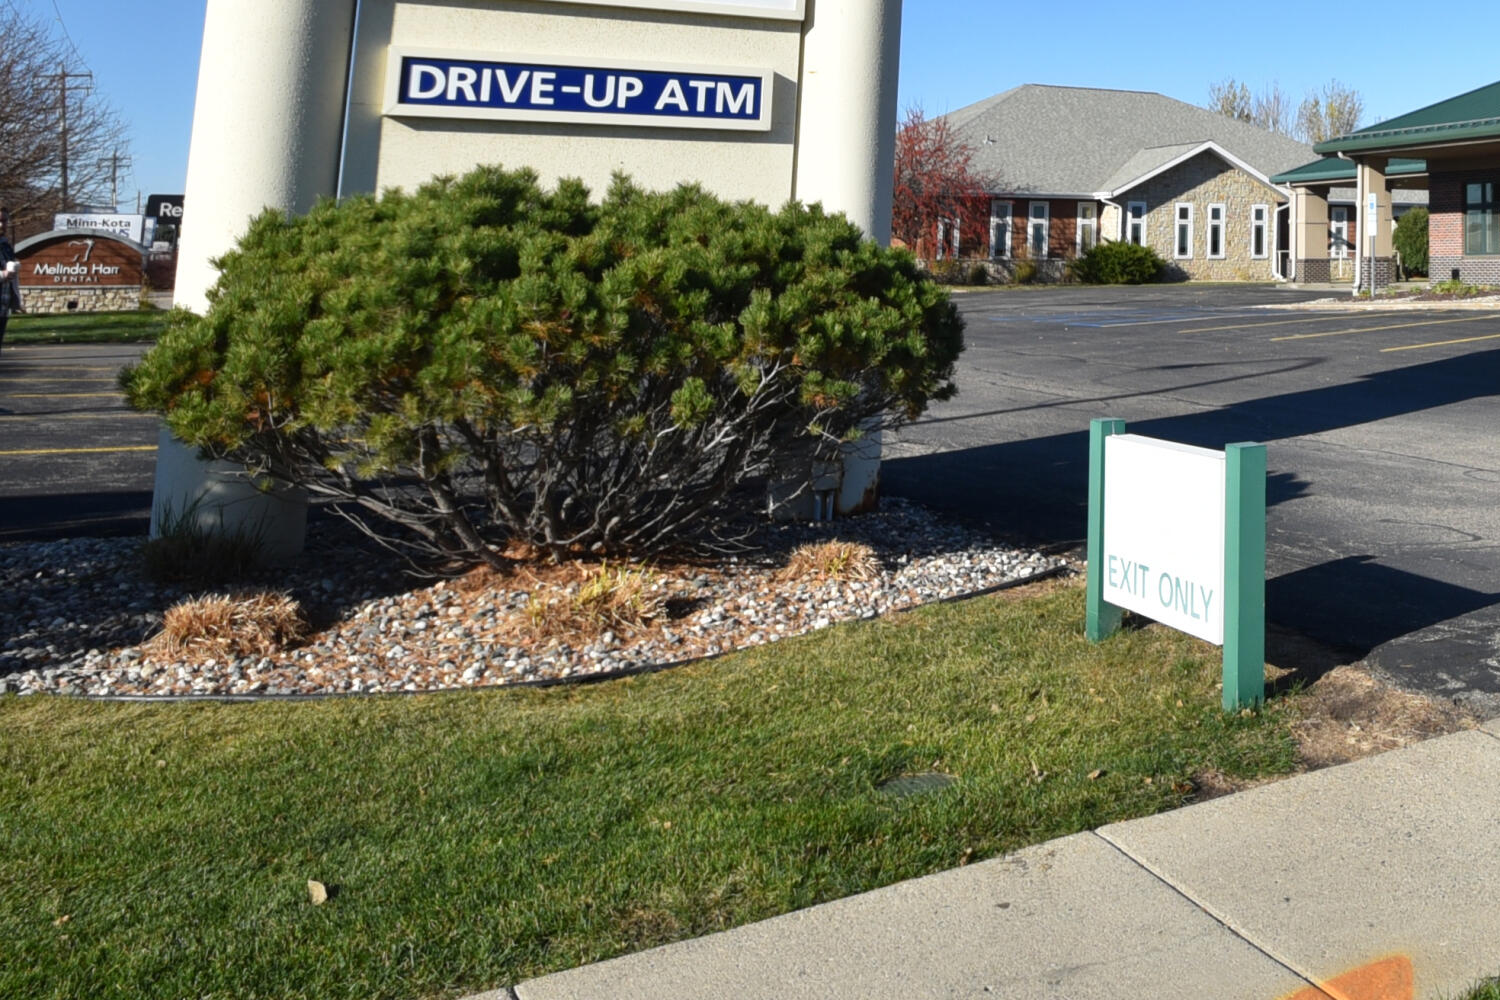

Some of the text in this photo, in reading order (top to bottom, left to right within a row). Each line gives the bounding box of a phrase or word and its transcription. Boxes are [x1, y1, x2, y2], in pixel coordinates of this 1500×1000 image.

[408, 64, 755, 115] DRIVE-UP ATM
[66, 218, 131, 228] Minn-Kota
[34, 263, 88, 275] Melinda
[54, 275, 99, 283] DENTAL
[1108, 554, 1213, 623] EXIT ONLY
